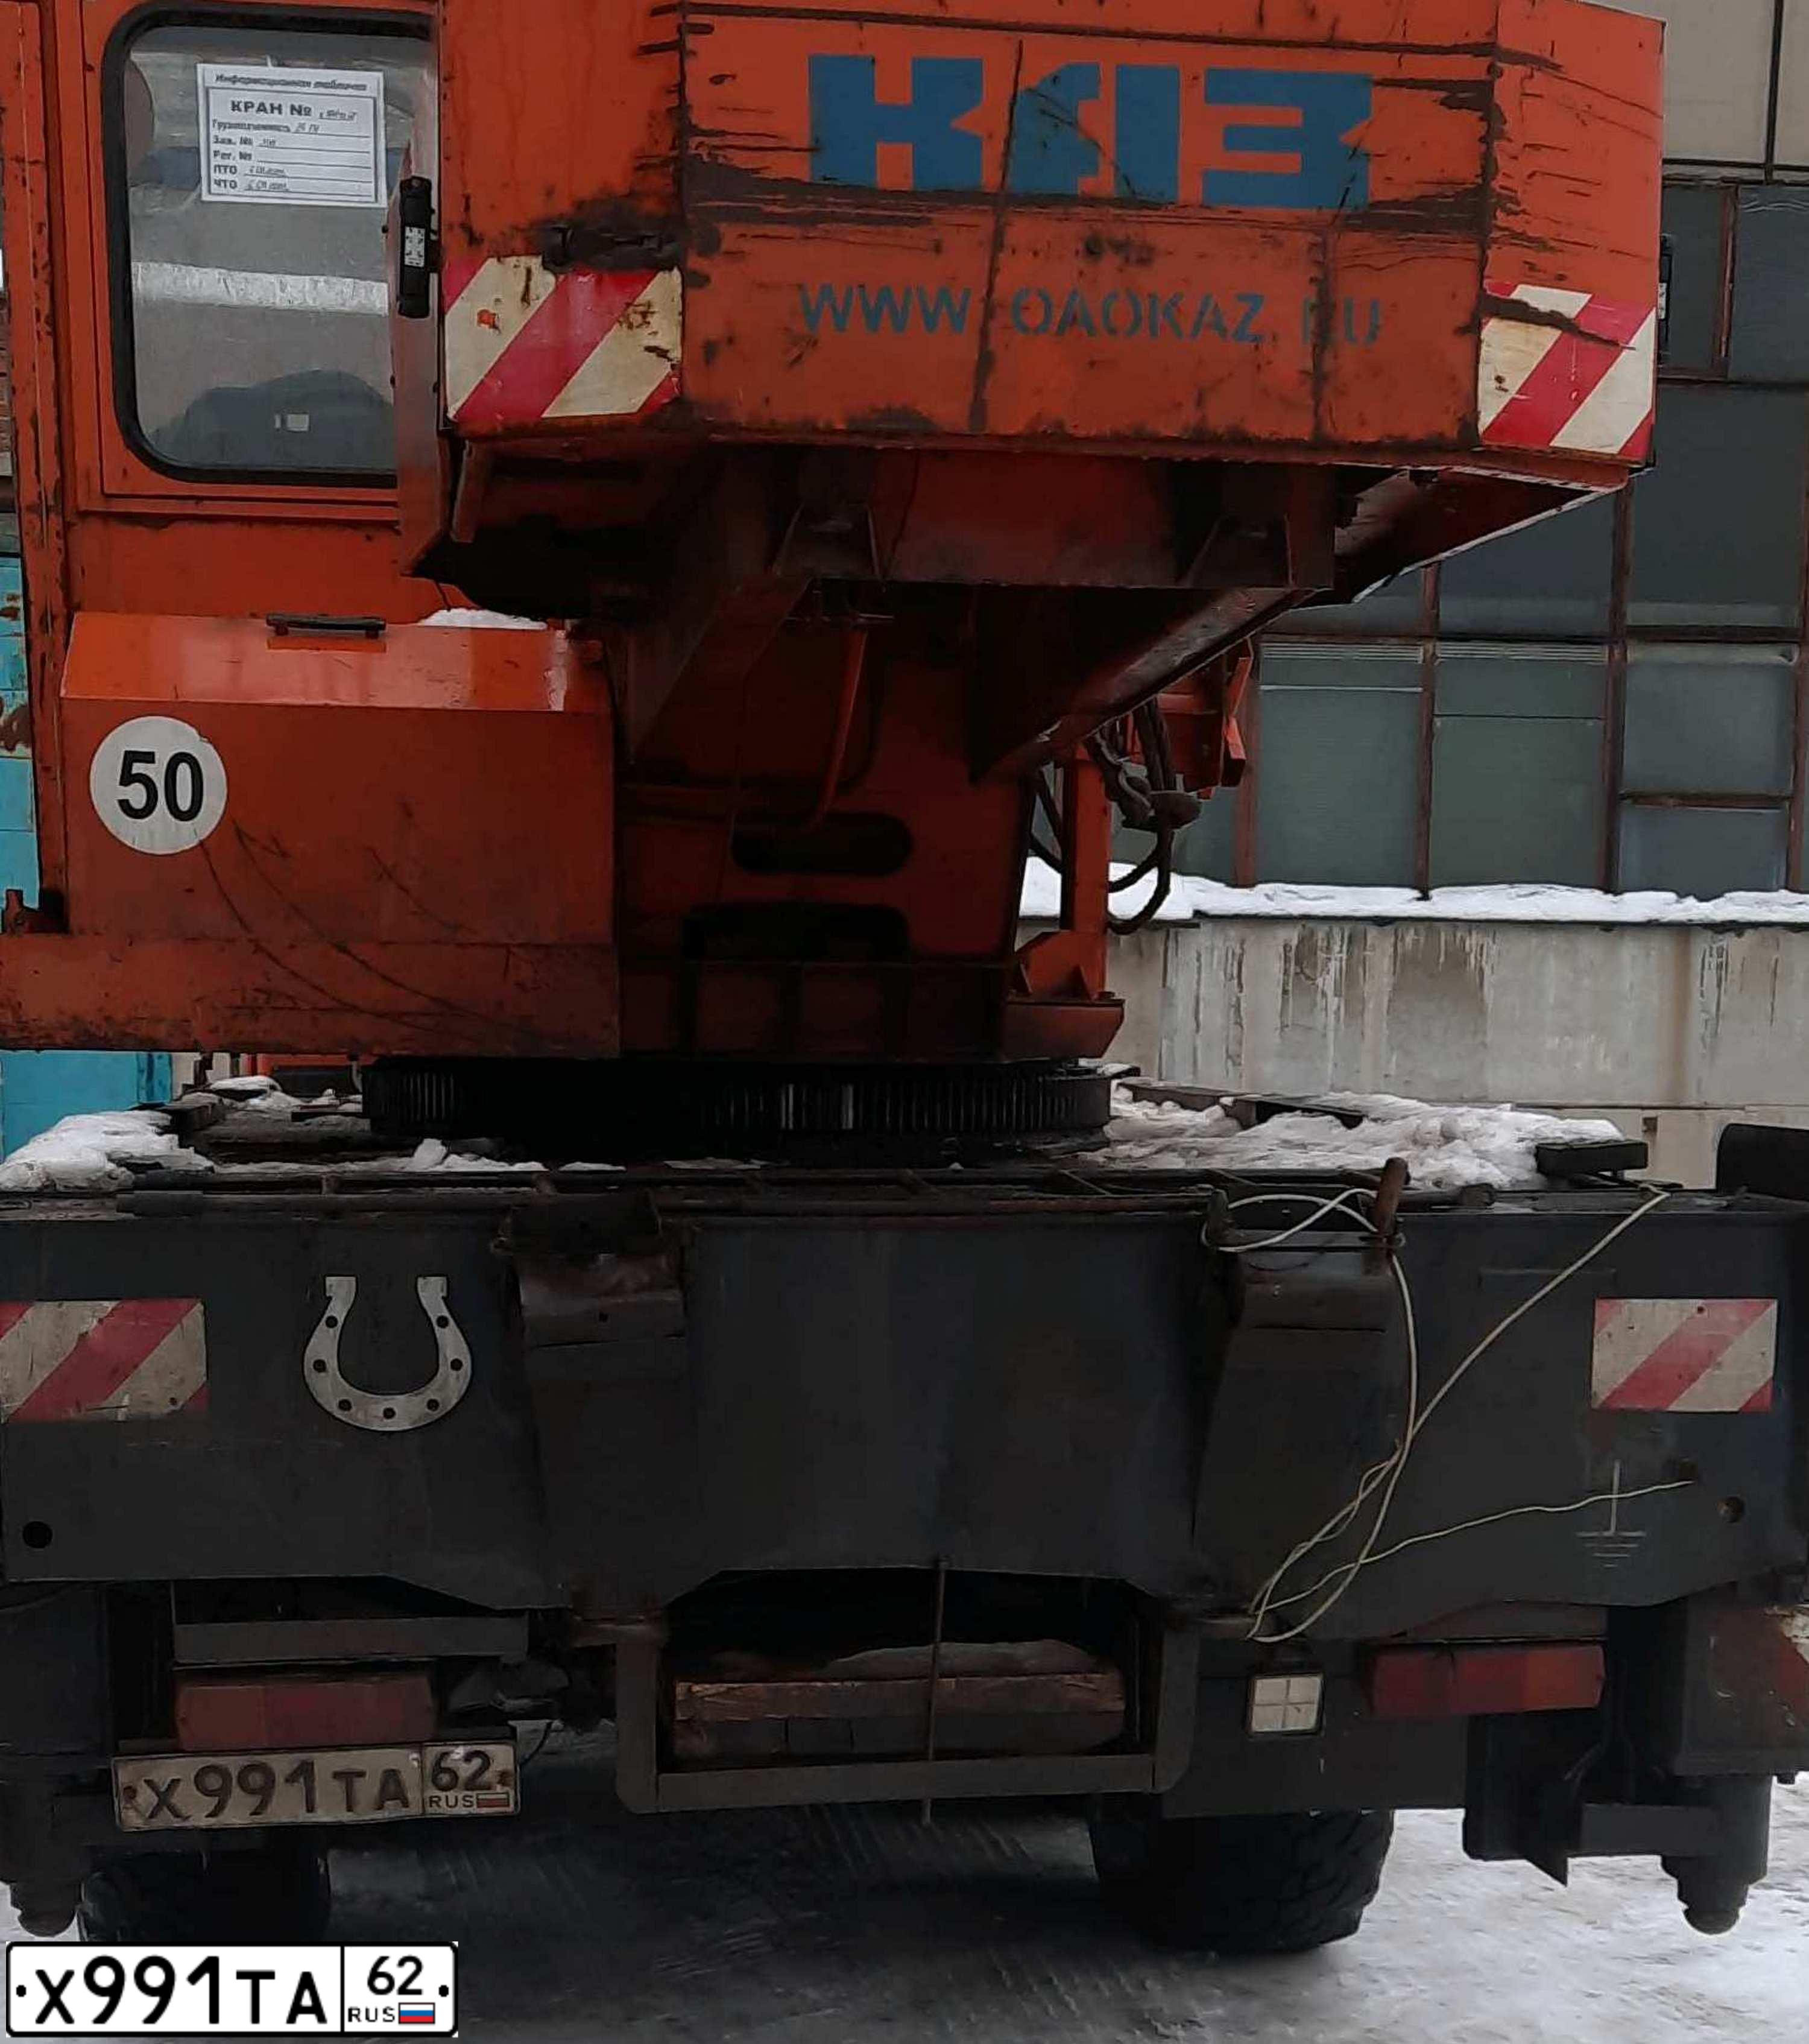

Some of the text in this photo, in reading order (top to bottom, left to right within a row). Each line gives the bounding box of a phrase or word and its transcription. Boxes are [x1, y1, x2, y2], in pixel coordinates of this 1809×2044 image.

[231, 100, 282, 115] КРАН
[290, 104, 312, 116] №
[213, 164, 238, 174] ПТО
[213, 179, 238, 189] ЧТО
[118, 750, 203, 821] 50
[432, 1750, 491, 1791] 62
[429, 1794, 475, 1808] RUS
